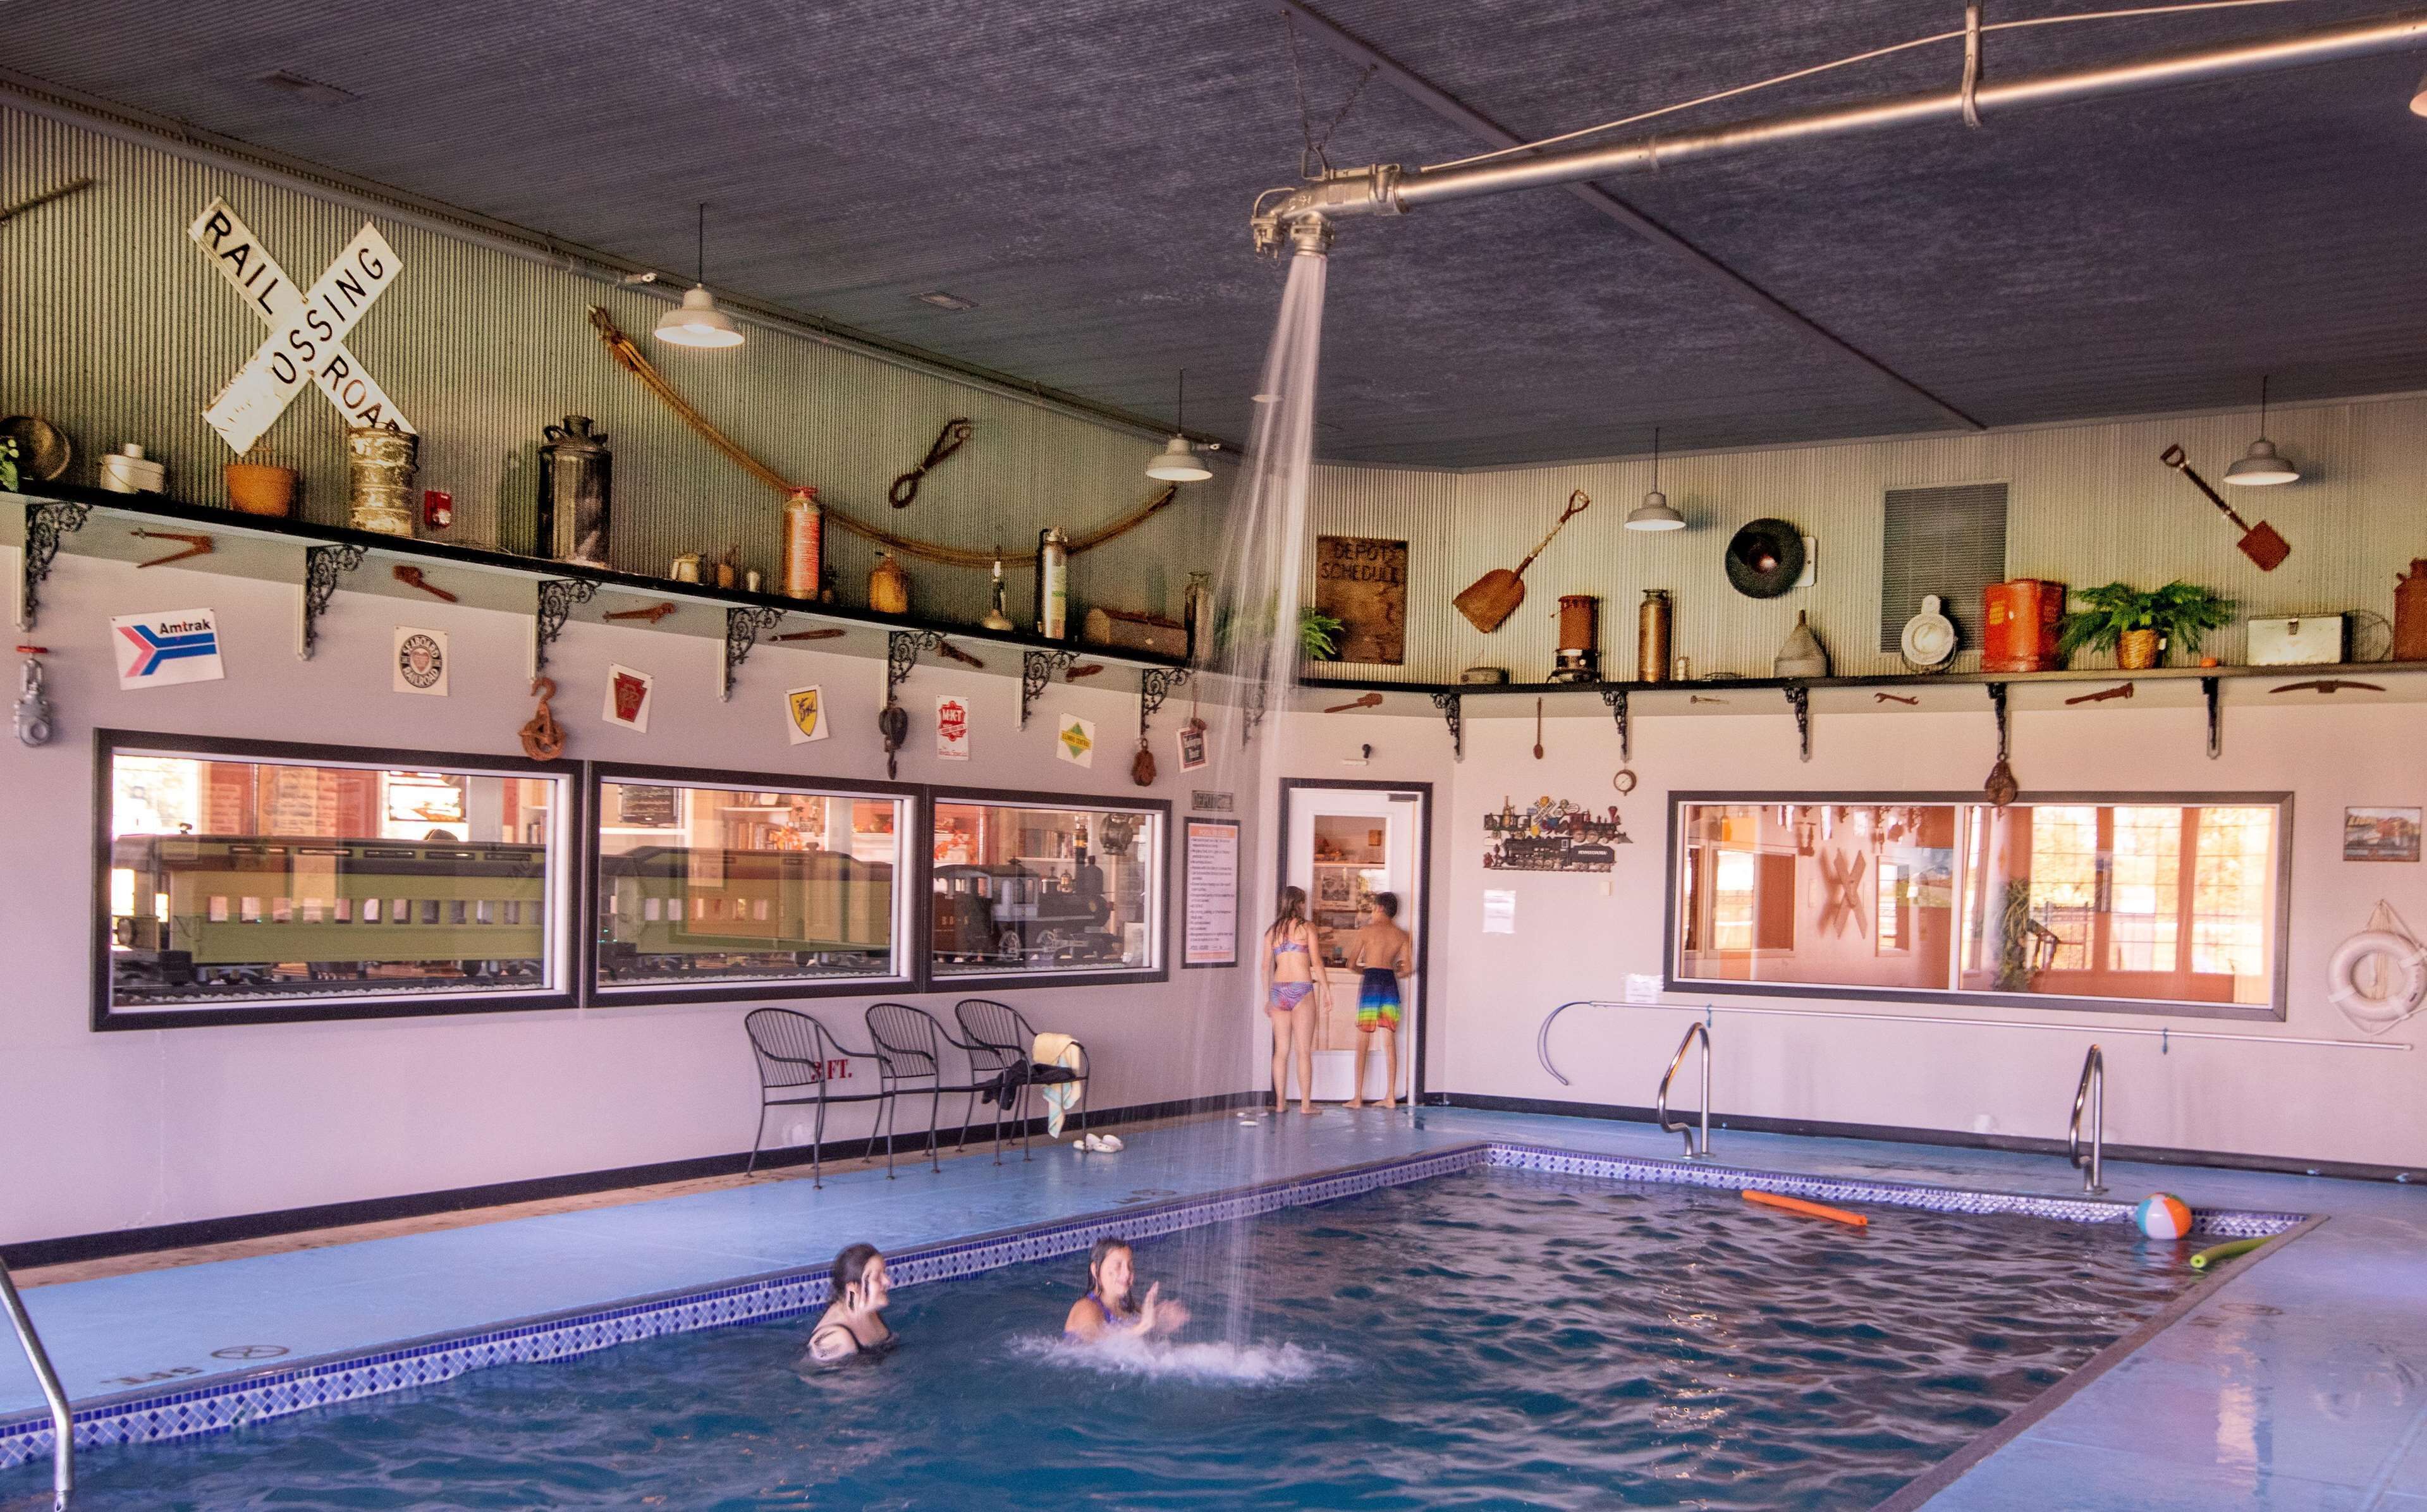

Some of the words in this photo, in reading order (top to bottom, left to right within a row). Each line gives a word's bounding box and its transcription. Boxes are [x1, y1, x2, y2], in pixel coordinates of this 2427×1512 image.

[204, 210, 279, 315] RAIL
[1335, 543, 1386, 561] DEPOT
[159, 619, 211, 635] Amtrak
[401, 636, 439, 658] SEABOARD
[401, 666, 439, 686] RAILROAD
